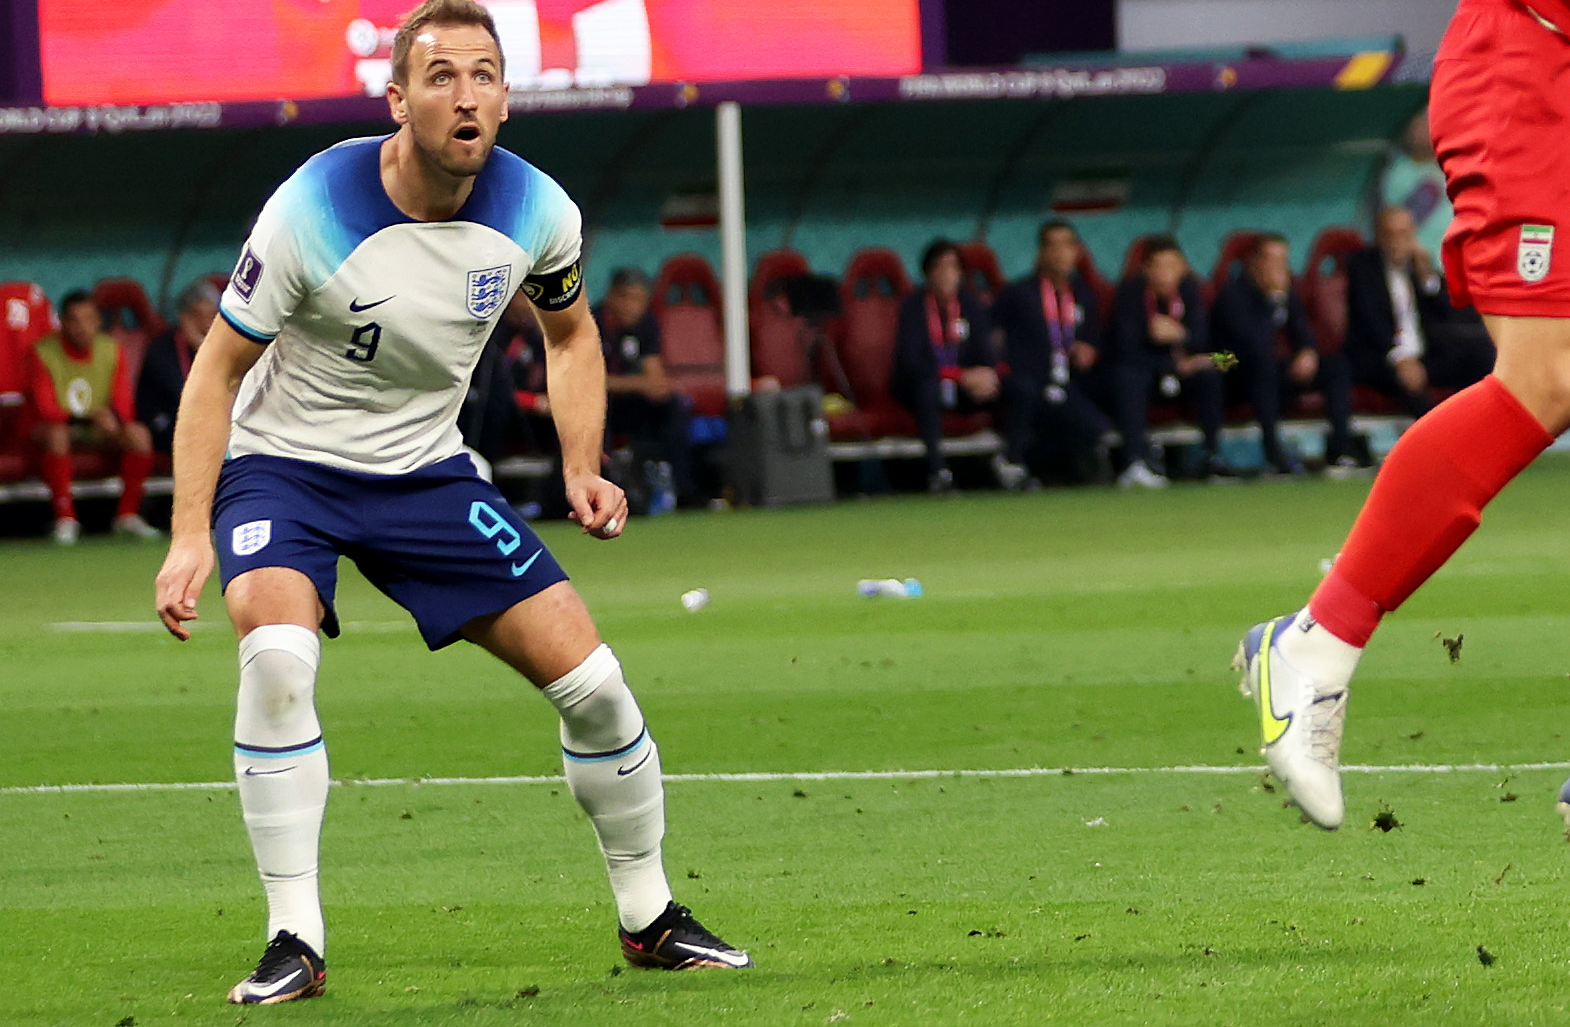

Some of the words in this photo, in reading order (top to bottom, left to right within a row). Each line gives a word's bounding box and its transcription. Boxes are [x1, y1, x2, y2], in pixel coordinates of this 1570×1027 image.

[562, 264, 579, 292] NO
[346, 322, 382, 361] 9
[468, 501, 521, 555] 9
